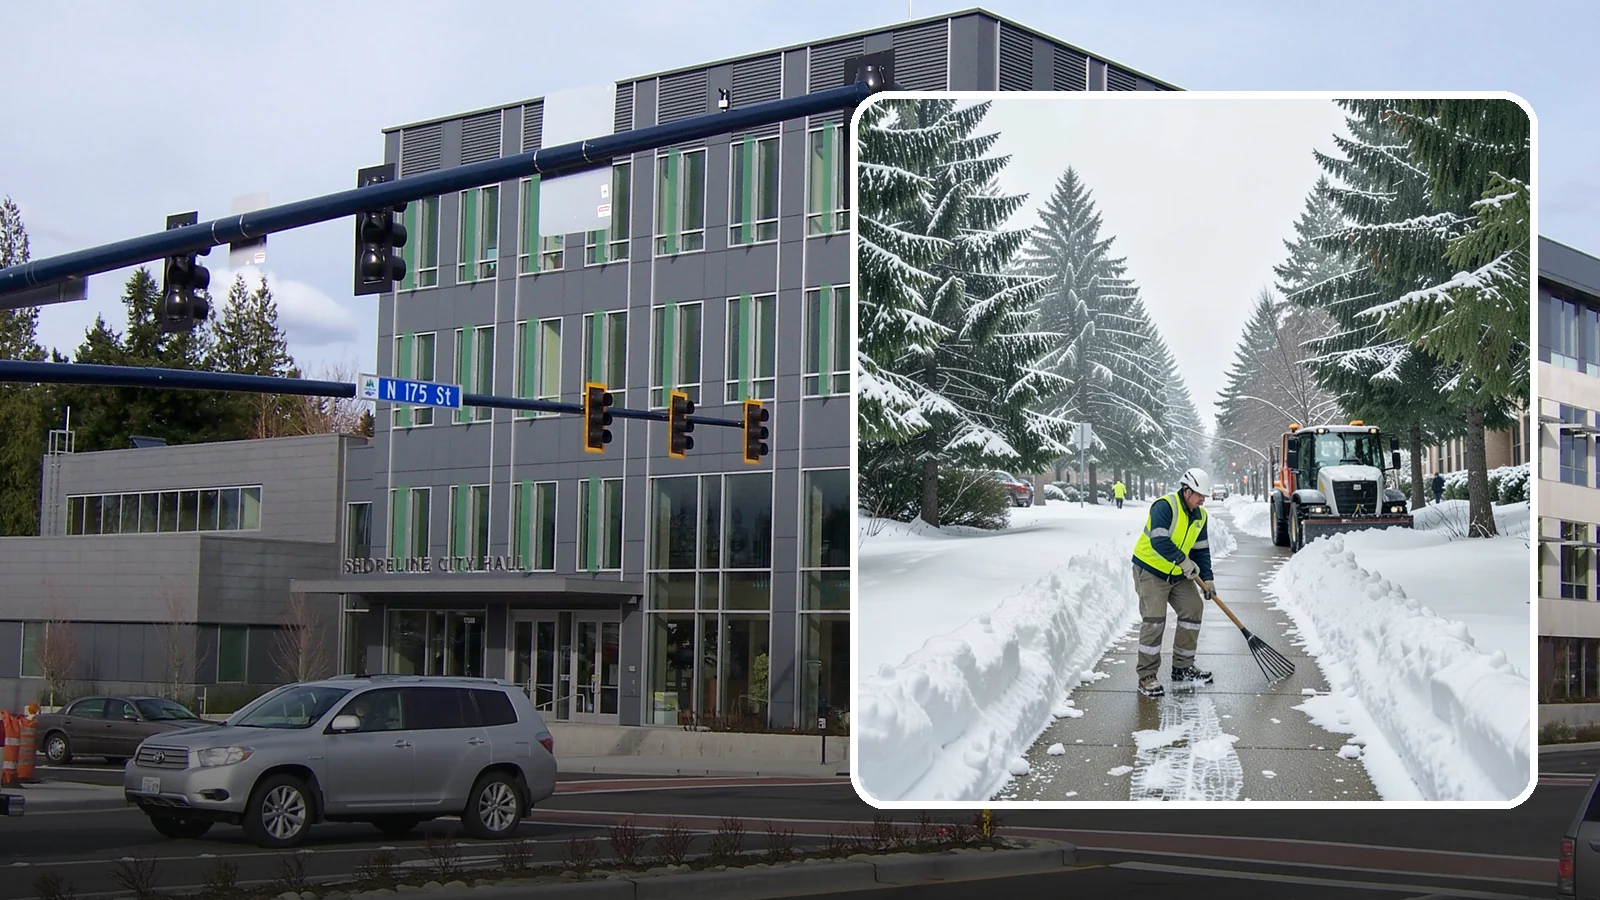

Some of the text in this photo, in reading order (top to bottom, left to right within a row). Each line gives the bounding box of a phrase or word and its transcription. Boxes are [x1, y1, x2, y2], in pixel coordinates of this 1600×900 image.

[387, 380, 451, 406] N 175 St
[344, 556, 526, 574] SHORELINE CITY HALL
